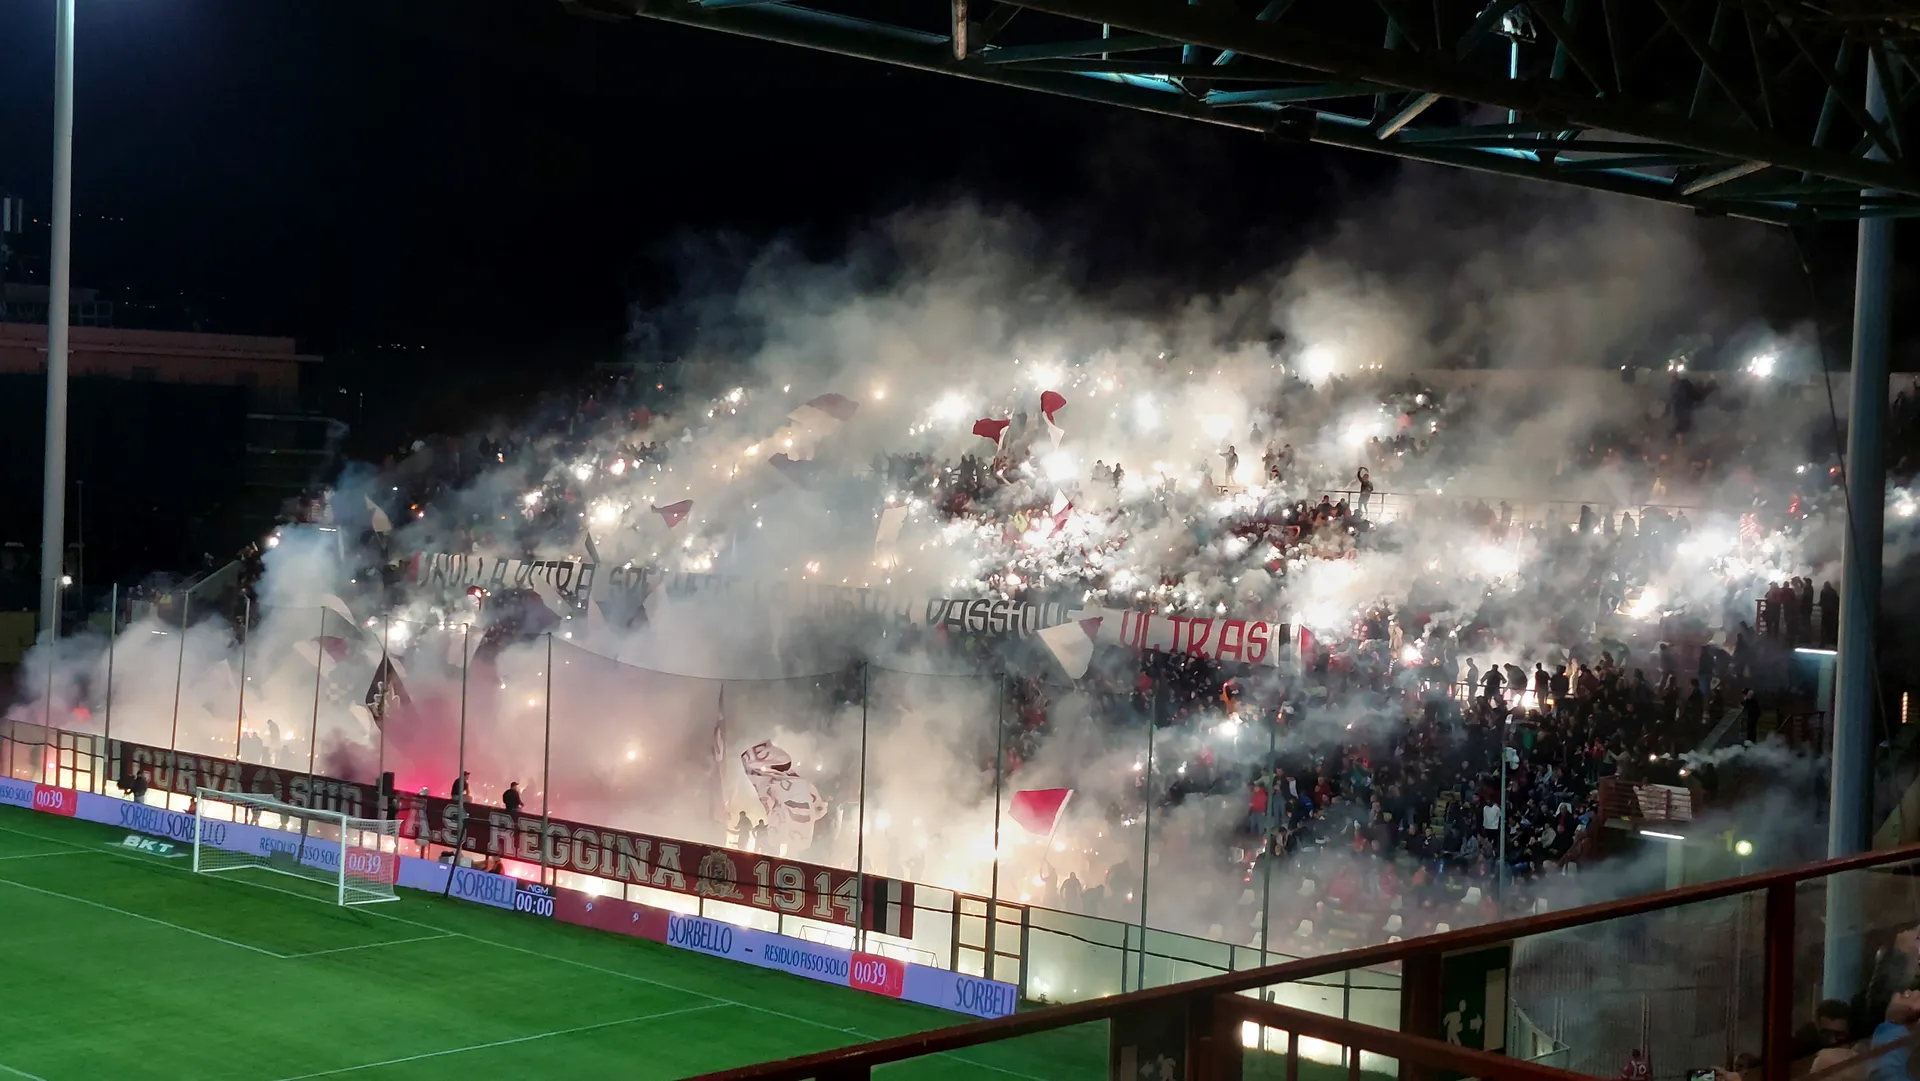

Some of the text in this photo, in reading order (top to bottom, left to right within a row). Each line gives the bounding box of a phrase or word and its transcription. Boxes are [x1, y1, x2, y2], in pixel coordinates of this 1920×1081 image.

[1120, 611, 1268, 664] ULTRAS
[123, 834, 175, 853] BKT
[166, 813, 226, 845] SORBLLO
[489, 811, 686, 890] REGGINA
[752, 860, 862, 924] 1914
[516, 893, 554, 917] 00:00
[527, 883, 550, 896] NGM
[669, 915, 733, 954] SORBELLO
[764, 943, 800, 967] RESIDUO
[799, 950, 823, 973] FISSO
[824, 957, 849, 978] SOLO
[853, 960, 887, 986] 0,039
